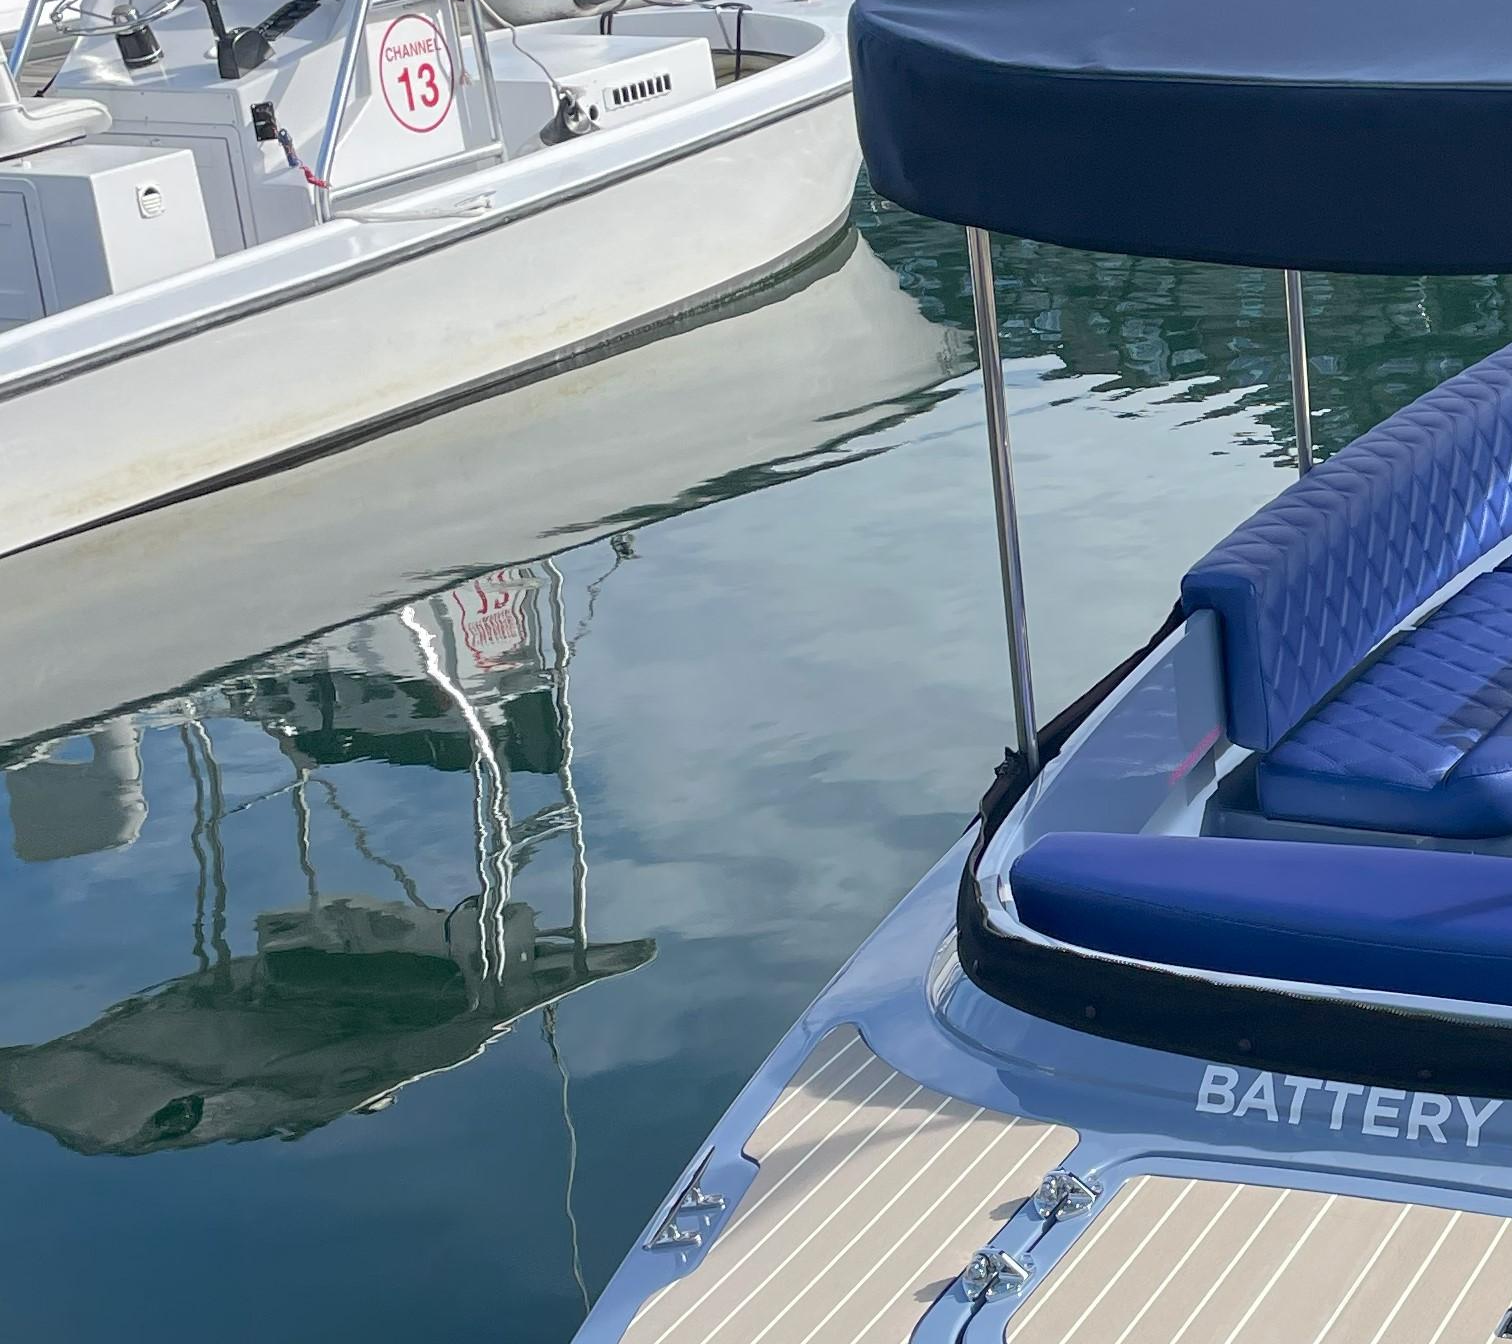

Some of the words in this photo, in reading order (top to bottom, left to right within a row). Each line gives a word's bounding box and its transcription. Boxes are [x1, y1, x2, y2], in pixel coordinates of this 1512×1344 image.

[385, 38, 442, 62] CHANNEL
[398, 63, 440, 112] 13
[1195, 1064, 1504, 1148] BATTERY
